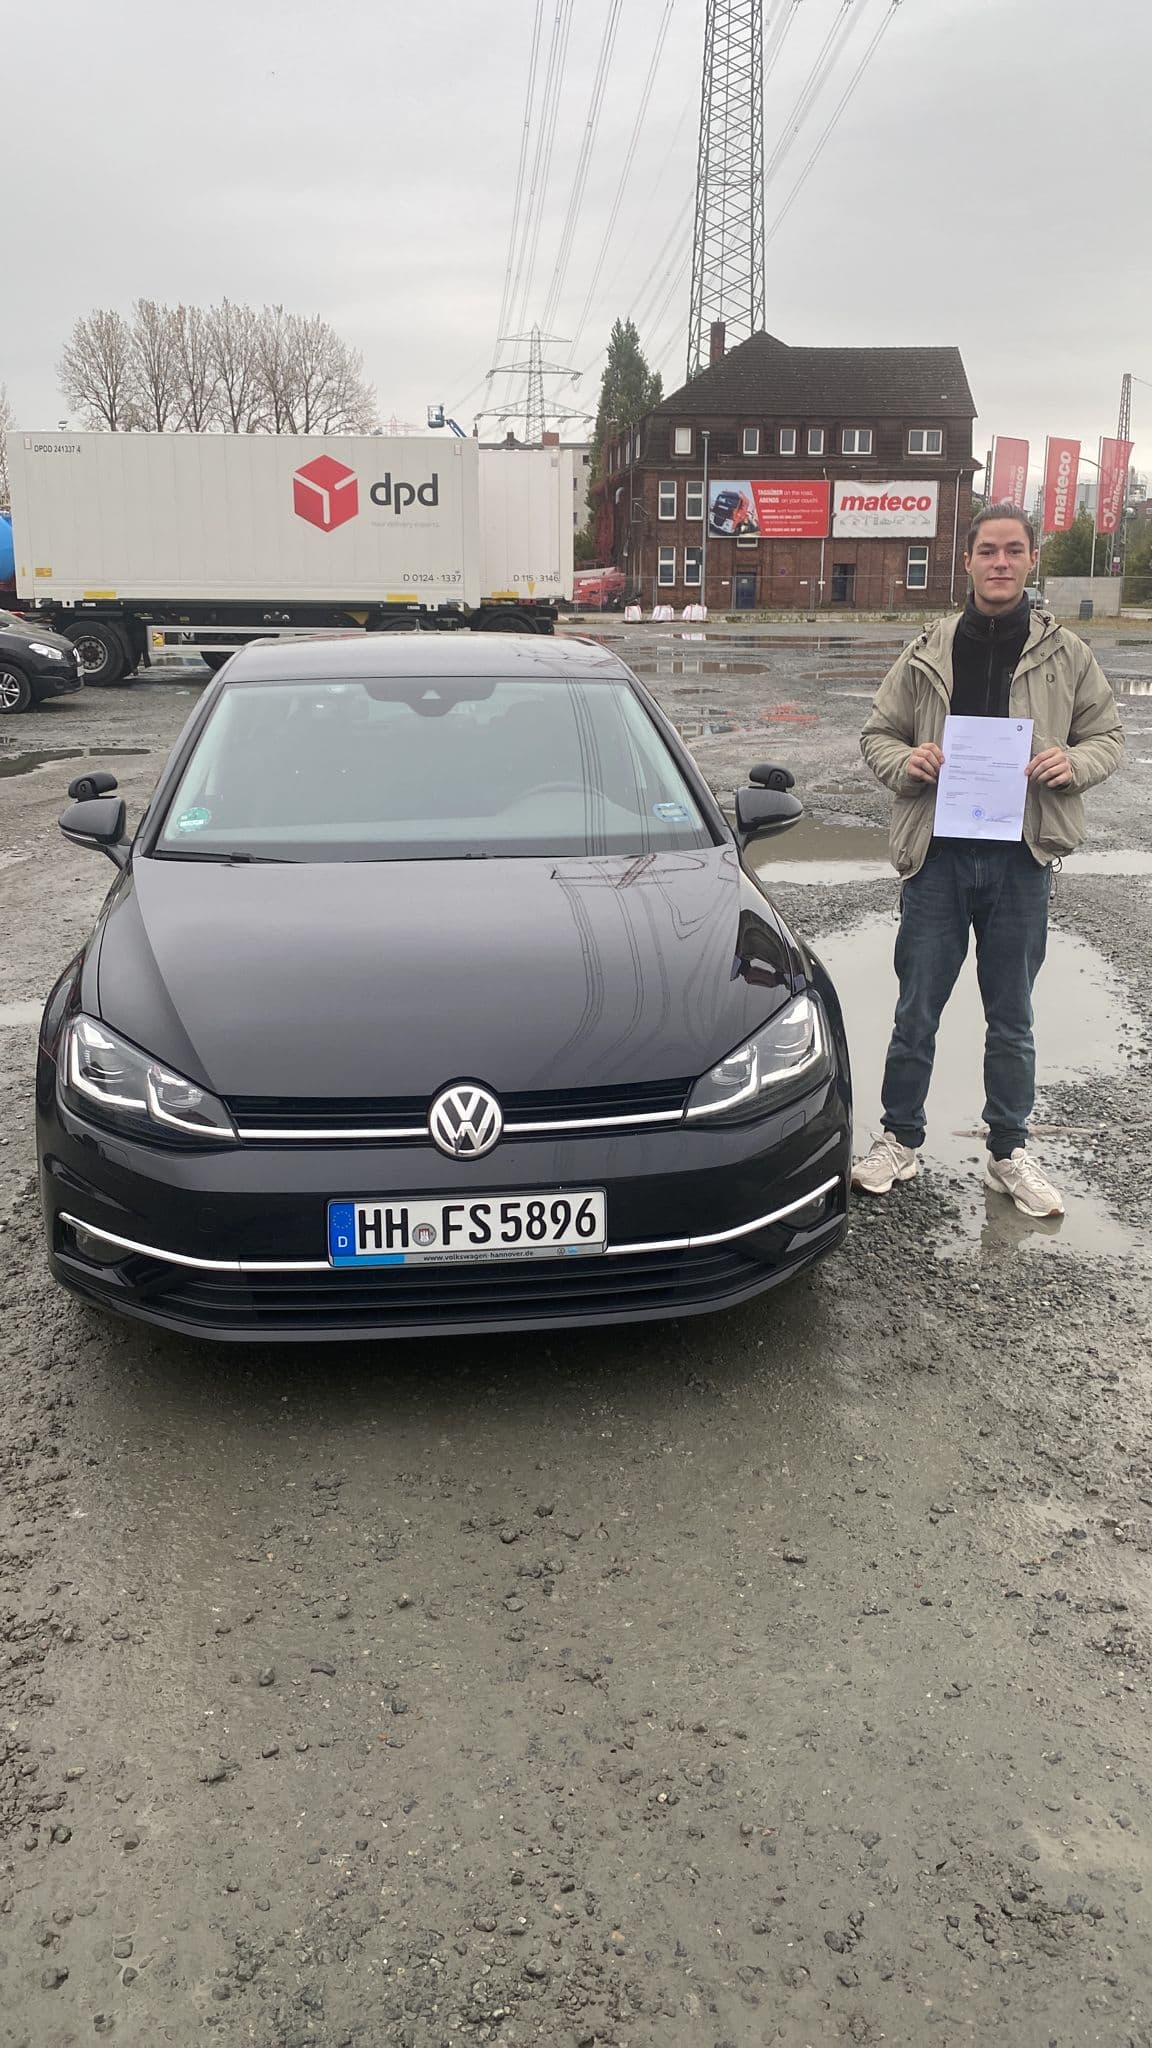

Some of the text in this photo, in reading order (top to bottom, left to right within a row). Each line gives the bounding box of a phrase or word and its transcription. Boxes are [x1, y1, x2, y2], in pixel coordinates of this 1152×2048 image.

[370, 472, 439, 515] dpd
[840, 492, 932, 511] mateco
[1055, 450, 1072, 526] mateco
[1111, 468, 1125, 513] mateco
[403, 573, 410, 582] D
[412, 573, 434, 582] 0124
[441, 573, 462, 582] 1337
[513, 574, 520, 582] D
[338, 1235, 348, 1248] D
[358, 1208, 409, 1249] HH
